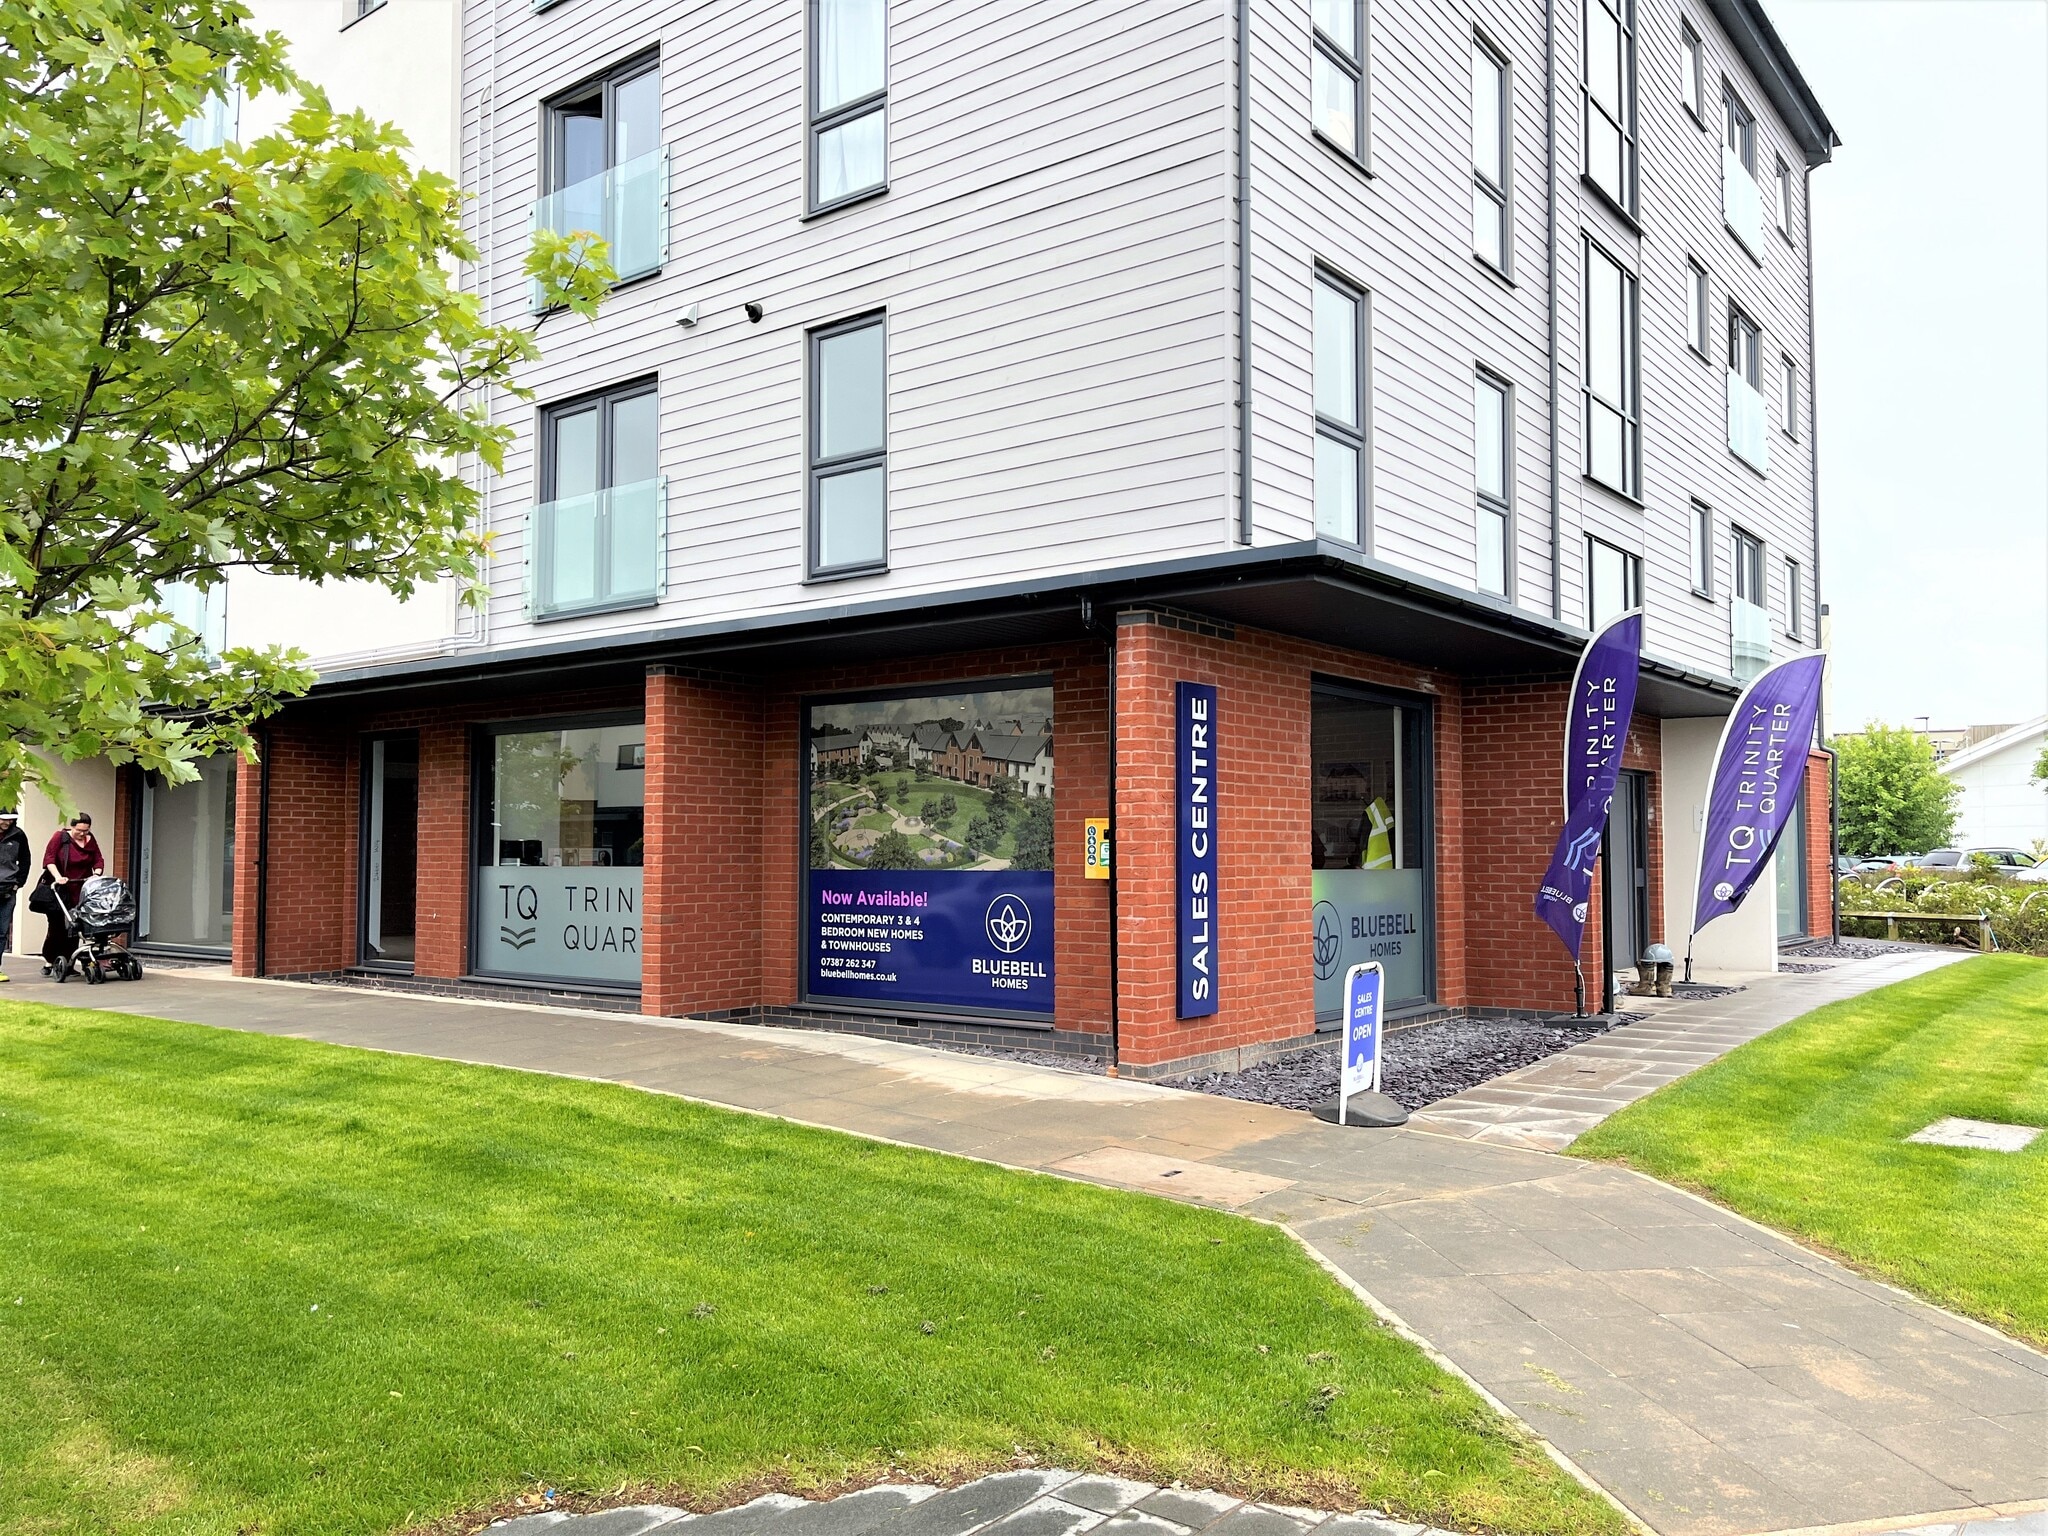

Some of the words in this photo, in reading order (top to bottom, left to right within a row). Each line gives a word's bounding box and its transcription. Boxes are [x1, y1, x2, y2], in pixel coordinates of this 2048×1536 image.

[1736, 704, 1768, 812] TRINITY
[1759, 703, 1792, 814] QUARTER
[1191, 697, 1208, 859] CENTRE
[1725, 825, 1755, 870] TQ
[498, 885, 538, 921] TQ
[822, 889, 853, 905] Now
[856, 890, 928, 907] Available!
[821, 913, 895, 925] CONTEMPORARY
[897, 915, 903, 926] 3
[905, 916, 912, 926] &
[913, 916, 921, 926] 4
[1351, 913, 1417, 938] BLUEBELL
[563, 924, 643, 953] QUAR
[821, 926, 866, 938] BEDROOM
[867, 928, 889, 939] NEW
[891, 929, 924, 940] HOMES
[1191, 871, 1209, 1000] SALES
[820, 939, 827, 949] &
[828, 940, 892, 953] TOWNHOUSES
[1370, 941, 1402, 958] HOMES
[820, 957, 844, 967] 07387
[845, 959, 860, 968] 262
[861, 959, 877, 969] 347
[972, 958, 1047, 978] BLUEBELL
[820, 968, 897, 982] bluebellhomes.co.uk
[991, 977, 1029, 990] HOMES
[1357, 992, 1373, 1005] SALES
[1354, 1005, 1373, 1019] CENTRE
[1352, 1023, 1373, 1042] OPEN
